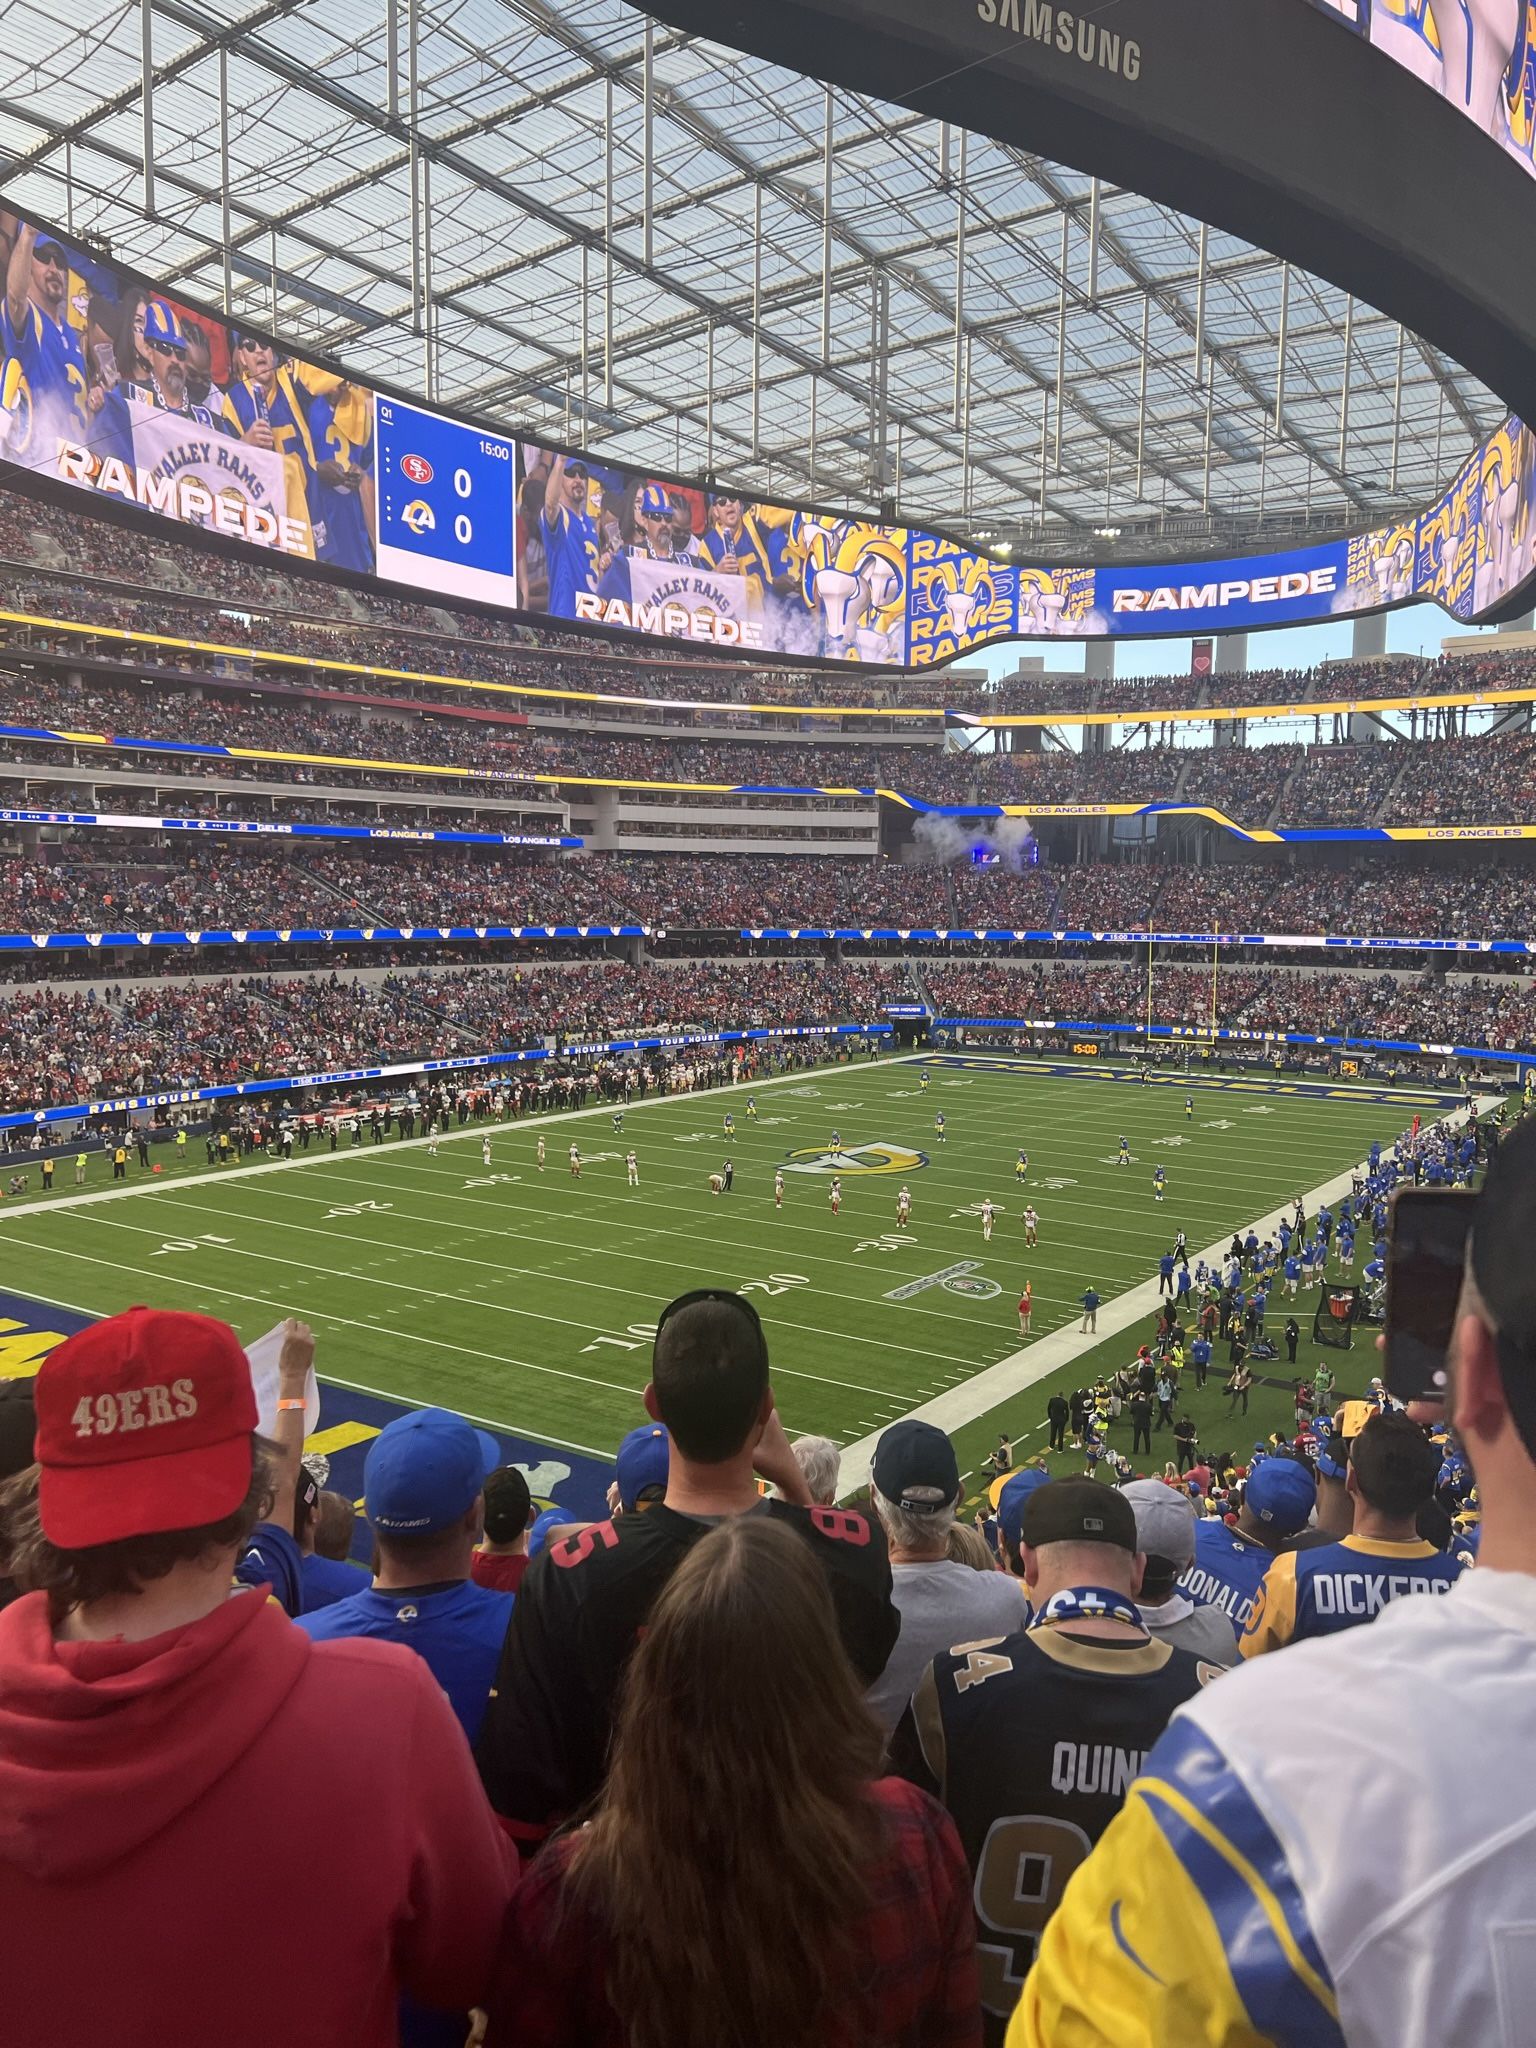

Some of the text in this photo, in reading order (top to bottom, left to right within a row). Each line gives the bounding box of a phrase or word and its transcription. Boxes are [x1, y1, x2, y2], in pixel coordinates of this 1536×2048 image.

[381, 406, 393, 419] Q1
[479, 440, 509, 461] 15:00
[217, 446, 265, 500] RAMS
[454, 468, 472, 498] 0
[56, 436, 308, 553] RAMPEDE
[454, 514, 473, 544] 0
[693, 578, 730, 612] RAMS
[1112, 566, 1337, 613] RAMPEDE
[575, 590, 763, 648] RAMPEDE
[370, 829, 435, 839] LOS ANGELES
[503, 836, 561, 845] LOS ANGELES
[660, 1034, 720, 1046] YOUR HOUSE
[1172, 1027, 1287, 1041] RAMS HOUSE
[575, 1045, 610, 1054] HOUSE
[1073, 1044, 1098, 1055] 15:00
[1067, 1070, 1443, 1105] ANGELES
[89, 1091, 200, 1115] RAMS HOUSE
[329, 1200, 394, 1217] 20
[161, 1233, 236, 1252] 10
[857, 1233, 919, 1253] 30
[740, 1272, 811, 1297] 20
[71, 1378, 198, 1437] 49ERS
